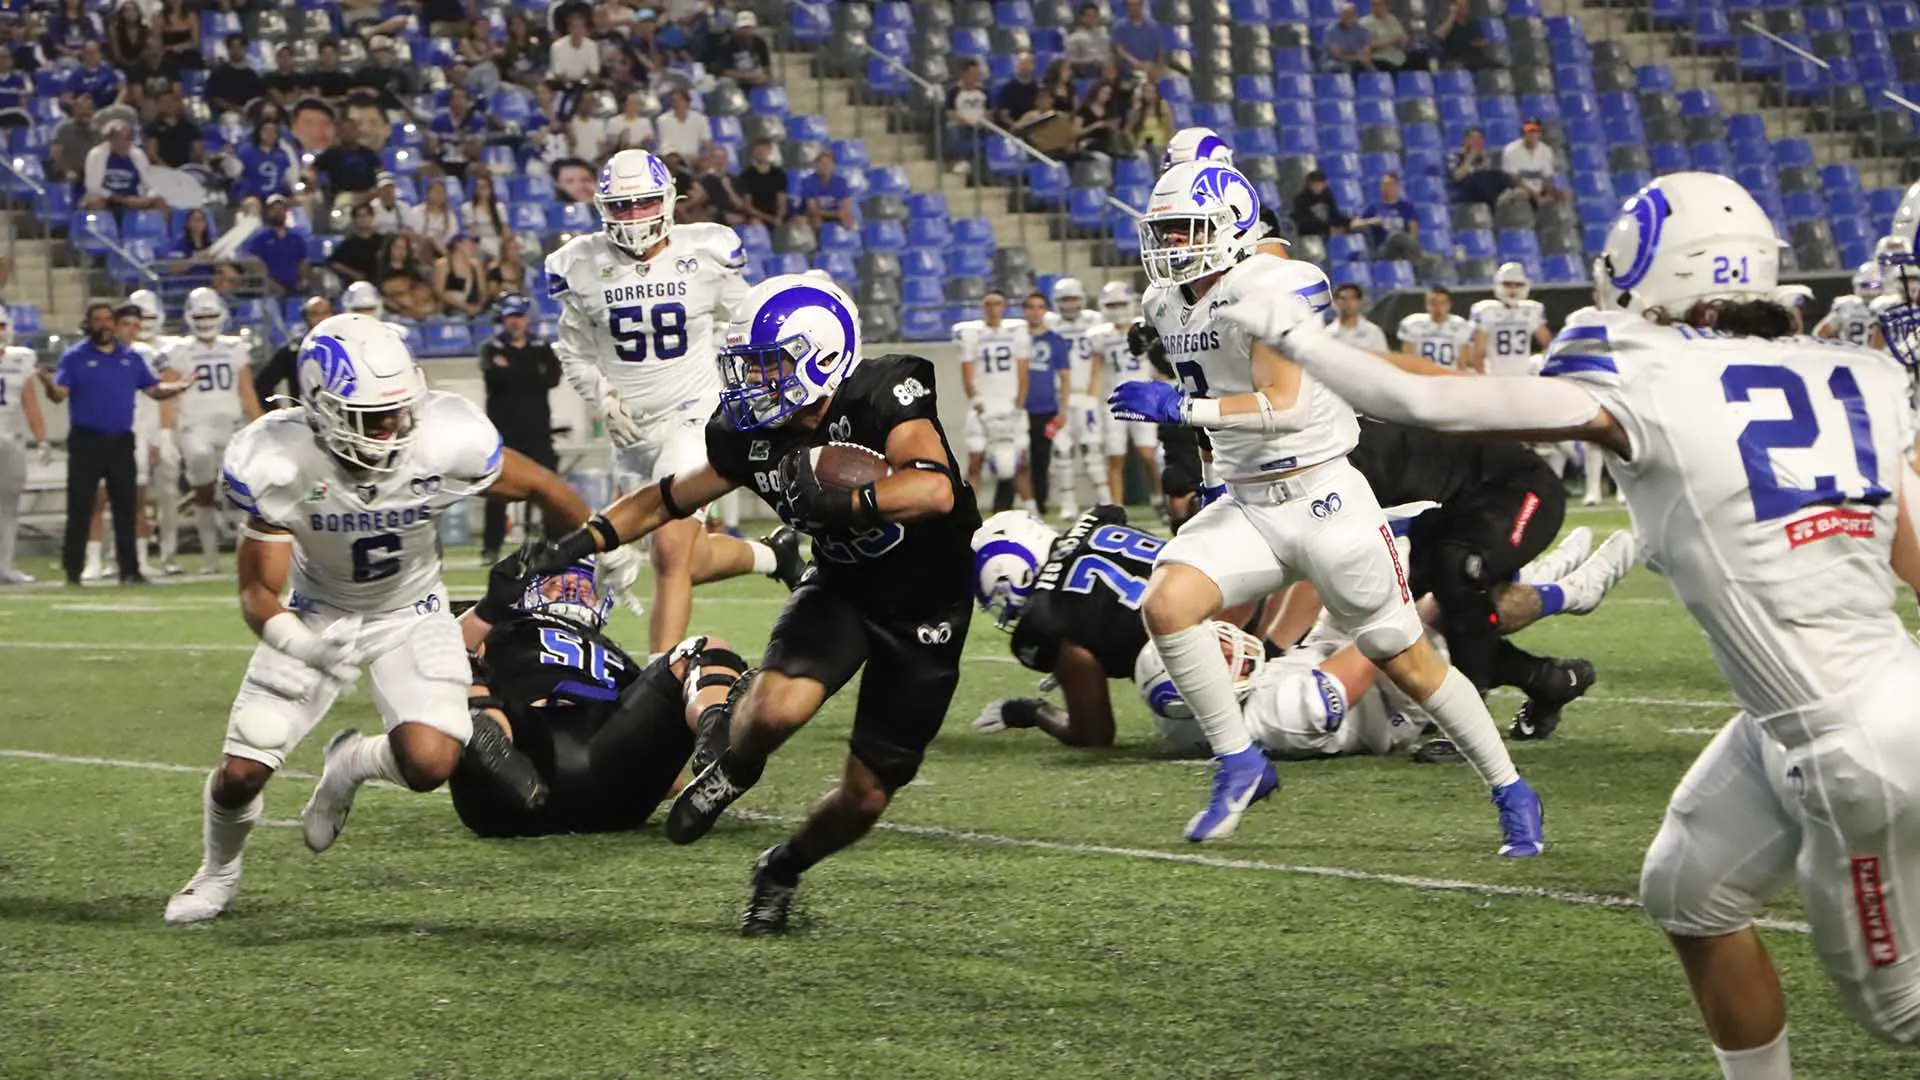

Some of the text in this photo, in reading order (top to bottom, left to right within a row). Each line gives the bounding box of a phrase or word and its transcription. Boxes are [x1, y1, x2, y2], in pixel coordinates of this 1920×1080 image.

[258, 160, 279, 192] 9
[604, 281, 688, 304] BORREGOS
[609, 302, 688, 362] 58
[1163, 329, 1220, 354] ORREGOS
[1496, 329, 1528, 355] 83
[983, 346, 1012, 374] 12
[1720, 364, 1893, 523] 21
[310, 504, 431, 532] BORREGOS
[1062, 524, 1169, 611] 78
